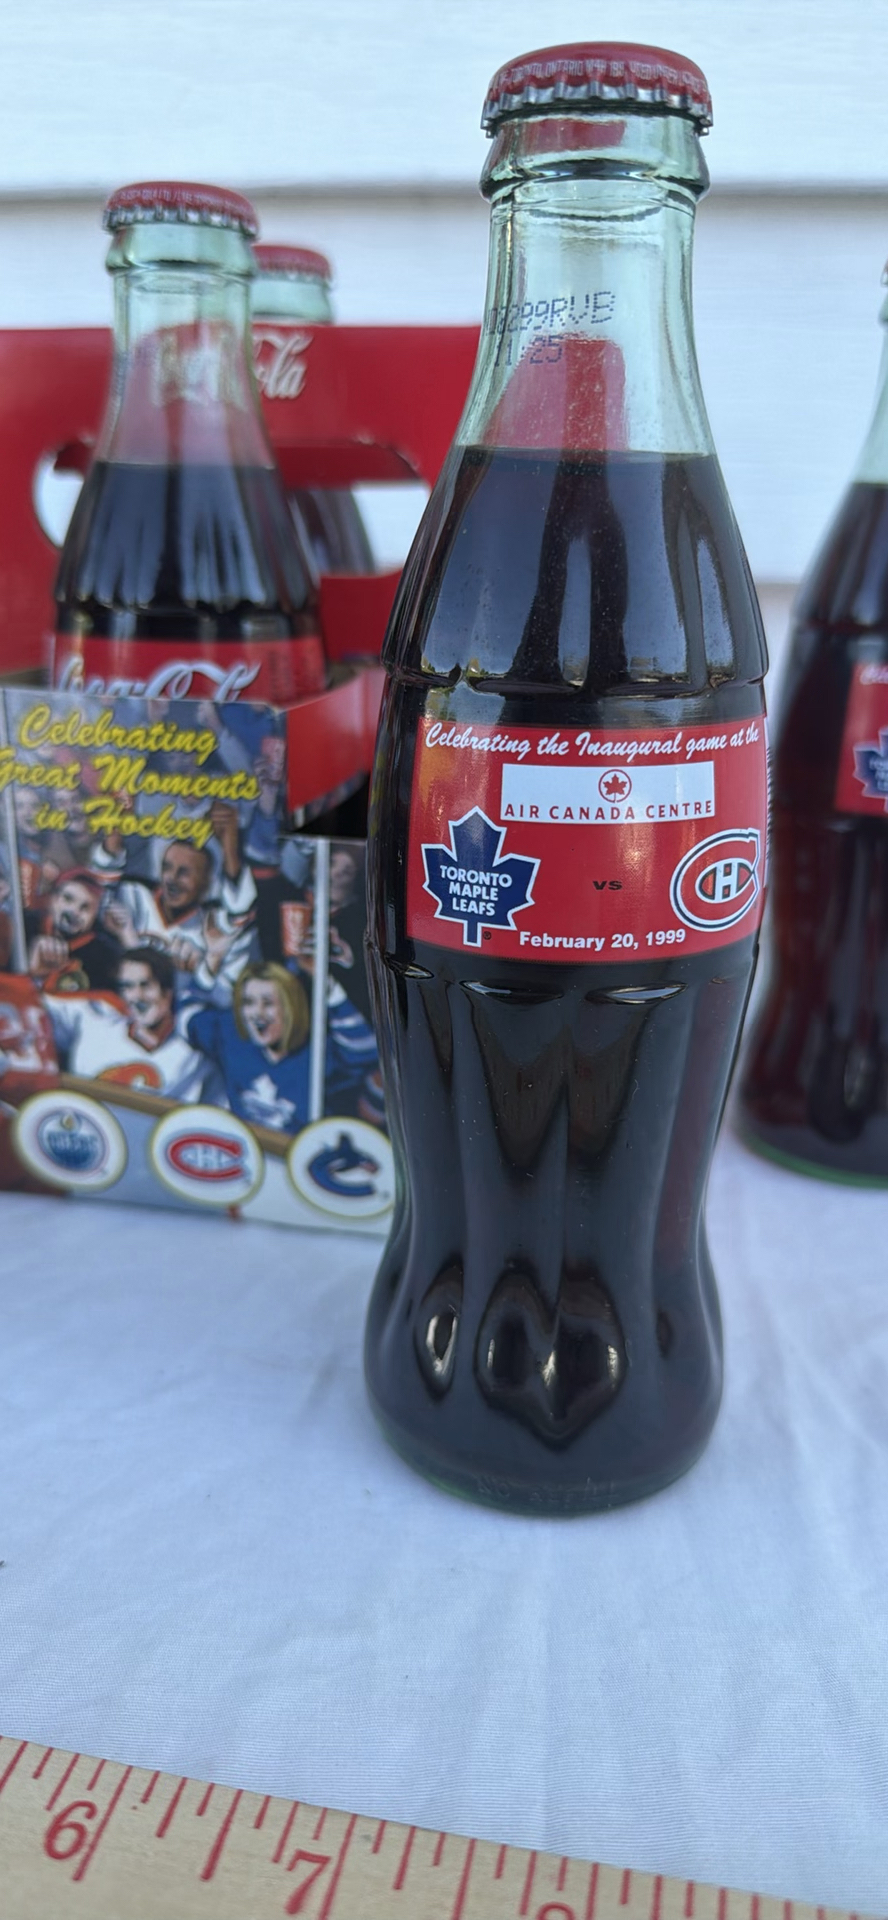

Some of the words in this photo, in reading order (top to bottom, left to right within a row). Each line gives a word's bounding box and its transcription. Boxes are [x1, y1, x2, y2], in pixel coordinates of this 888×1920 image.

[19, 703, 219, 766] Celebrating
[425, 721, 532, 761] Celebrating
[537, 732, 570, 756] the
[575, 731, 683, 763] Inaugural
[686, 734, 728, 760] game
[730, 731, 745, 747] at
[746, 721, 760, 745] the
[93, 753, 261, 800] Moments
[35, 803, 70, 832] in
[84, 797, 214, 850] Hockey
[504, 802, 540, 819] AIR
[549, 805, 636, 820] CANADA
[645, 800, 712, 818] CENTRE
[440, 865, 513, 888] TORONTO
[449, 881, 499, 901] MAPLE
[452, 897, 496, 917] LEAFS
[519, 931, 606, 952] February
[611, 933, 639, 950] 20,
[645, 928, 686, 946] 1999
[43, 1799, 98, 1861] 6
[284, 1848, 331, 1916] 7
